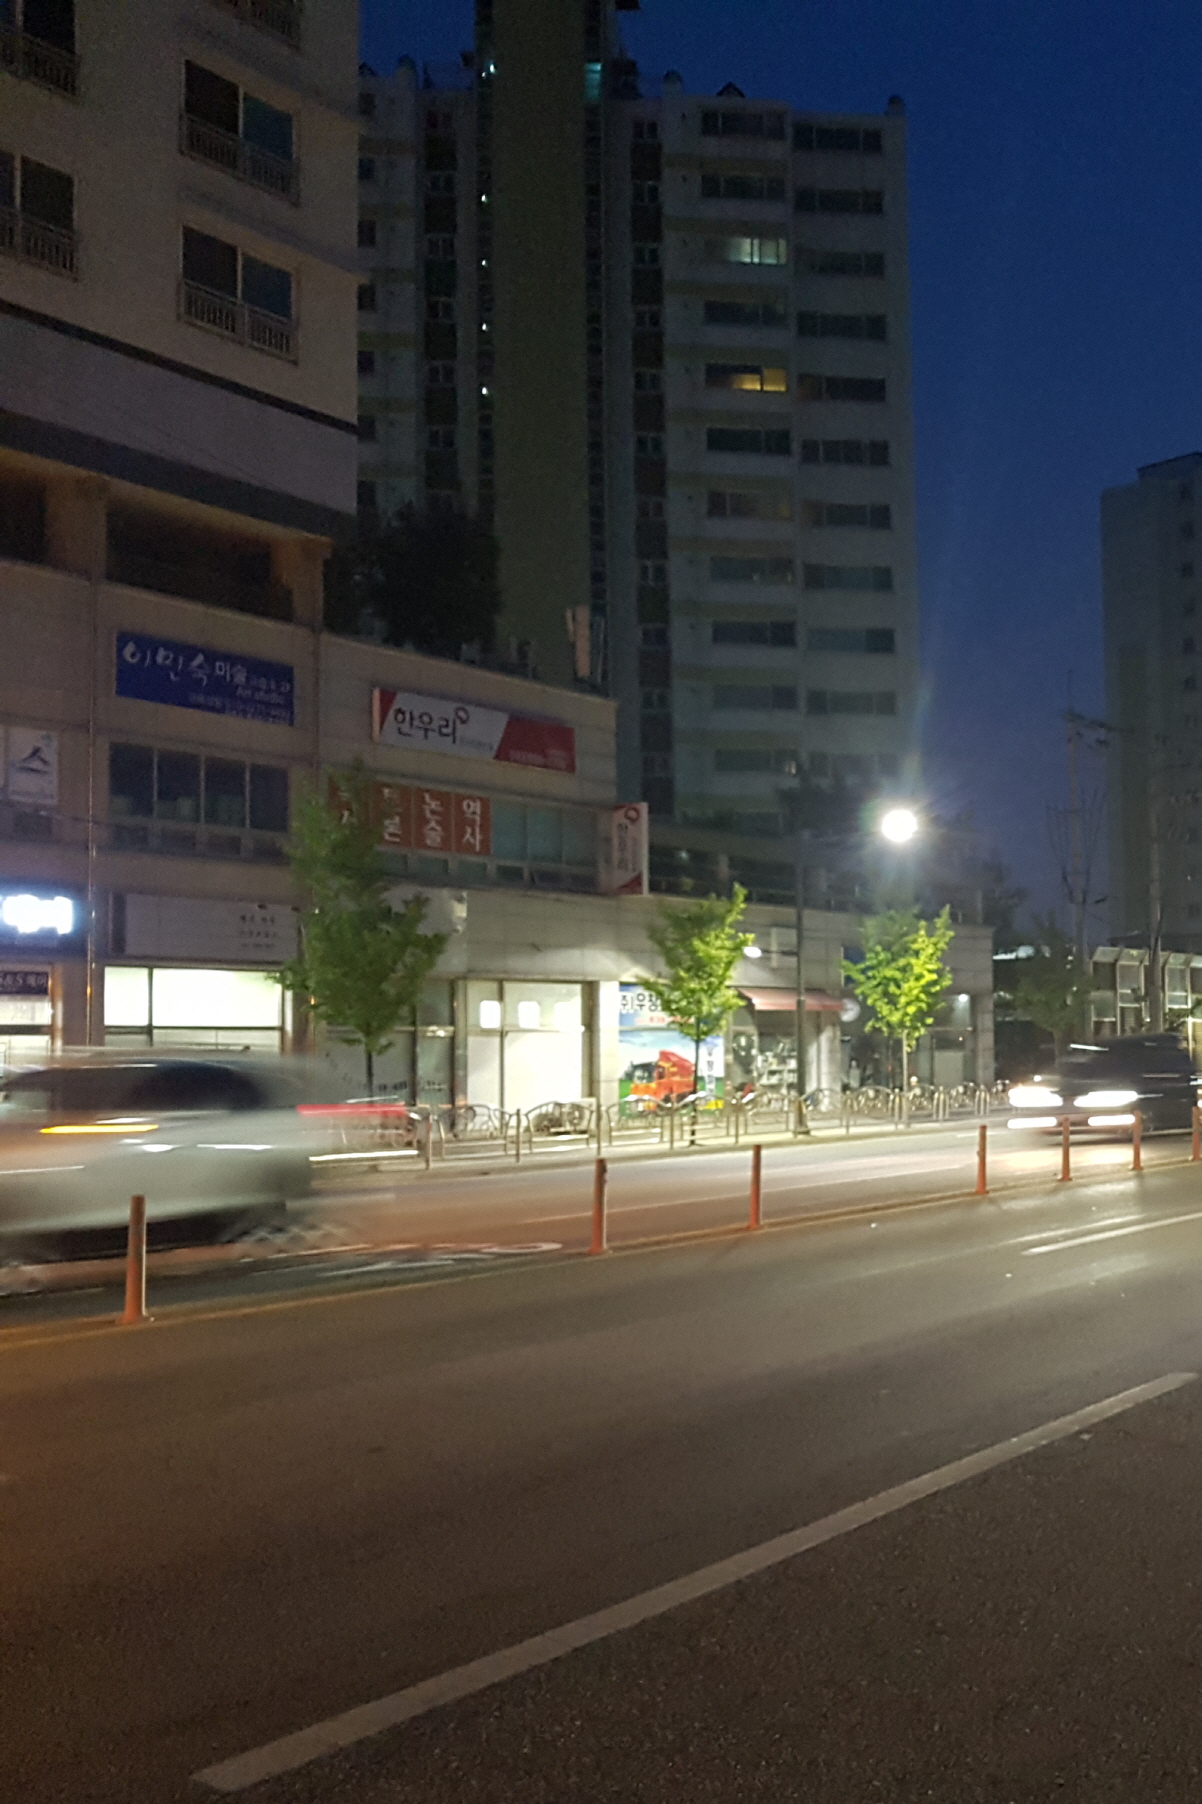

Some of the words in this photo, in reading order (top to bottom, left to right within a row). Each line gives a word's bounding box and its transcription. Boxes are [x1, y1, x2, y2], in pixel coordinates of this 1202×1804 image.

[394, 708, 457, 744] 한우리
[422, 792, 445, 848] 논술
[461, 798, 483, 853] 역사
